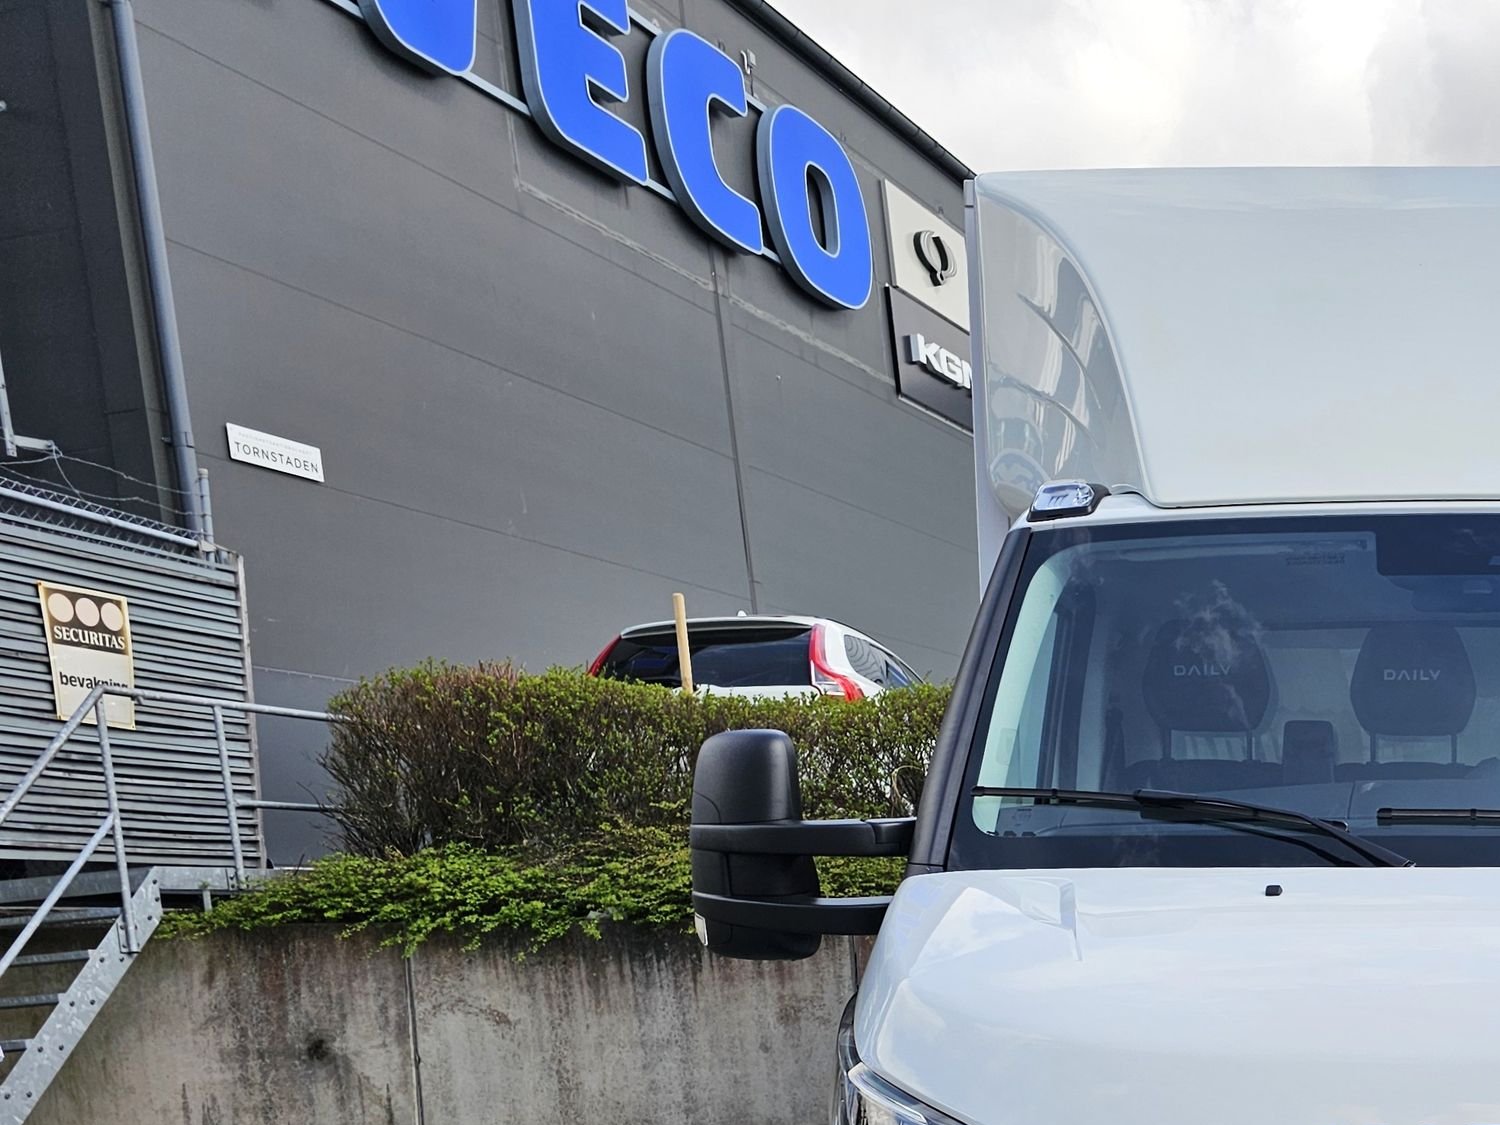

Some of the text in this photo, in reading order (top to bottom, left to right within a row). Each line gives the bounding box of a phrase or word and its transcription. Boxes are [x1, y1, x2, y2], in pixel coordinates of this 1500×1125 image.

[234, 441, 319, 473] TORNSTADEN
[53, 625, 126, 650] SECURITAS
[1173, 664, 1232, 676] DAILY
[1383, 669, 1441, 681] DAILY
